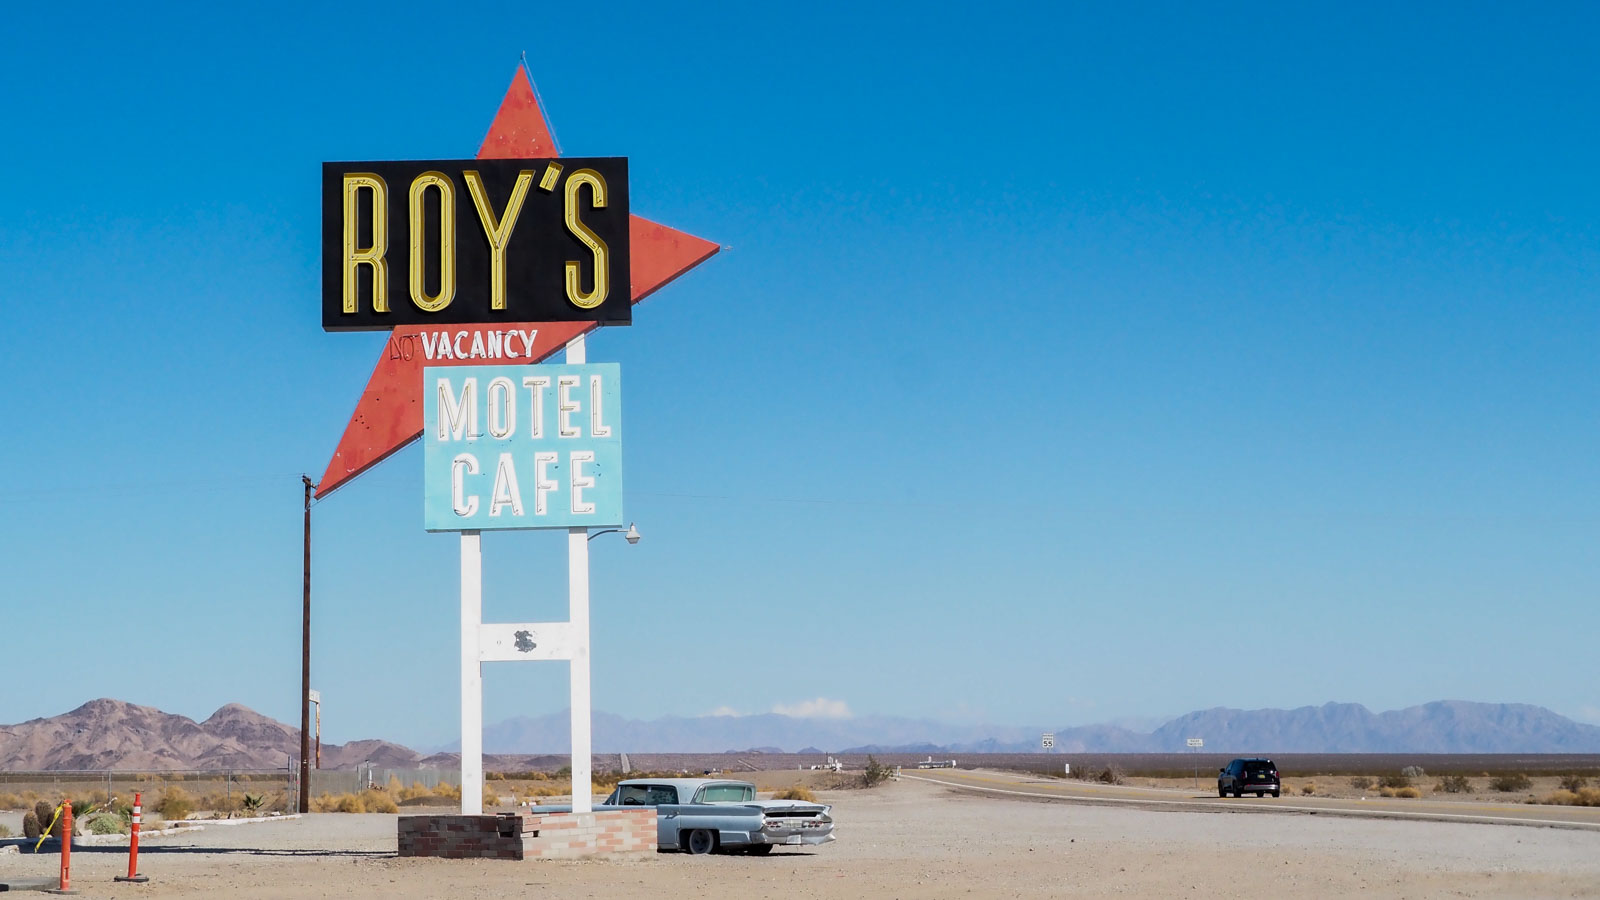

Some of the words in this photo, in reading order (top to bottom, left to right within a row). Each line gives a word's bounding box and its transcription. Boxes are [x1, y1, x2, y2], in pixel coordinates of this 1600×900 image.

[343, 161, 610, 313] ROY'S
[389, 334, 415, 361] NO
[420, 330, 538, 359] VACANCY
[438, 375, 611, 441] MOTEL
[452, 451, 596, 518] CAFE
